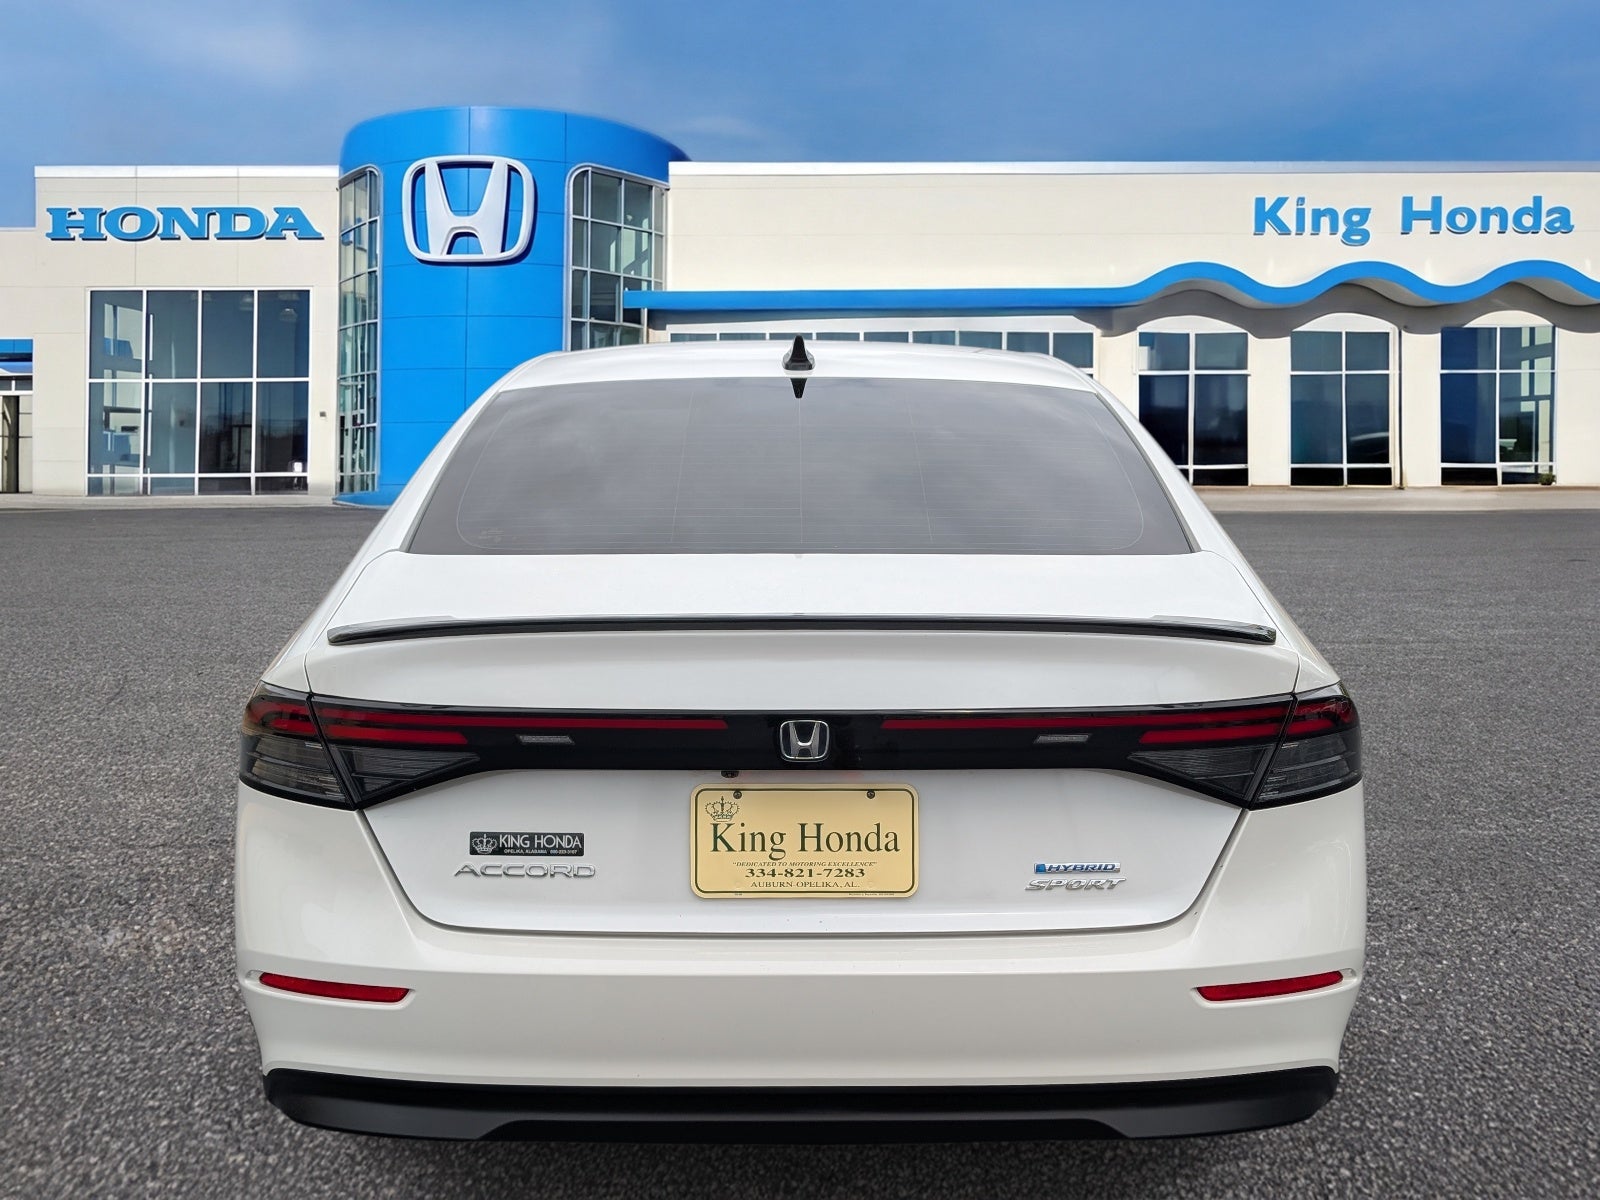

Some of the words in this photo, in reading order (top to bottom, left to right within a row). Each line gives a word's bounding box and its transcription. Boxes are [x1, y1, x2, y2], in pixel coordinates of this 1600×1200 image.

[46, 206, 325, 242] HONDA
[1253, 196, 1372, 246] King
[1401, 195, 1575, 235] Honda
[499, 834, 531, 849] KING
[534, 834, 583, 849] HONDA
[710, 822, 787, 861] King
[798, 822, 900, 853] Honda
[454, 863, 596, 878] ACCORD
[744, 868, 866, 878] 334-821-7283
[1047, 863, 1116, 872] HYBRID
[1024, 877, 1127, 891] SPORT
